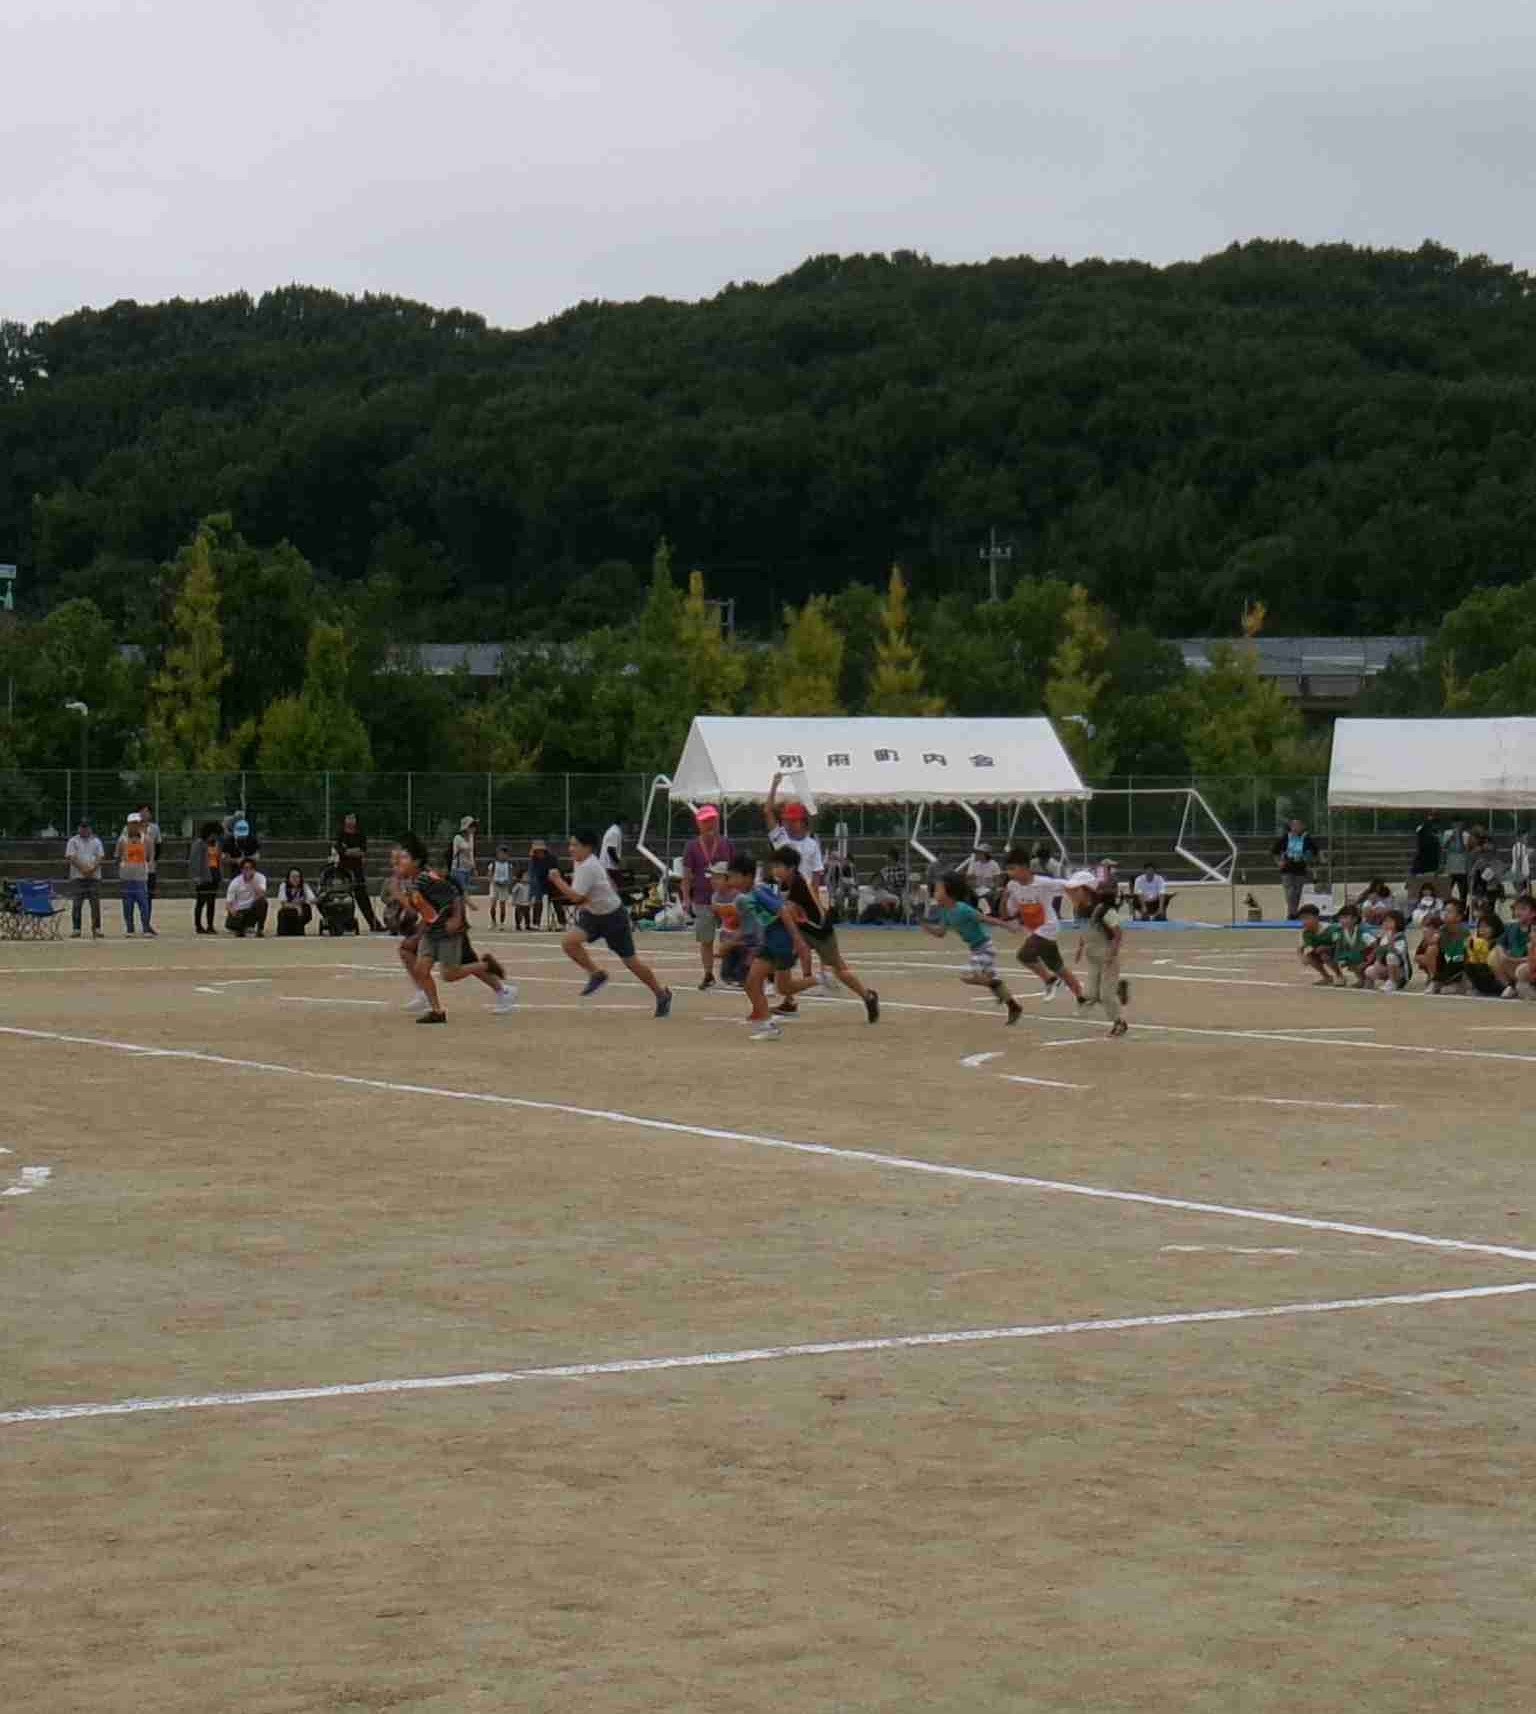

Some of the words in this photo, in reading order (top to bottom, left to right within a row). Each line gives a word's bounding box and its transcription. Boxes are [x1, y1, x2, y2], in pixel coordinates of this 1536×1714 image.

[776, 748, 996, 769] 別府町内会
